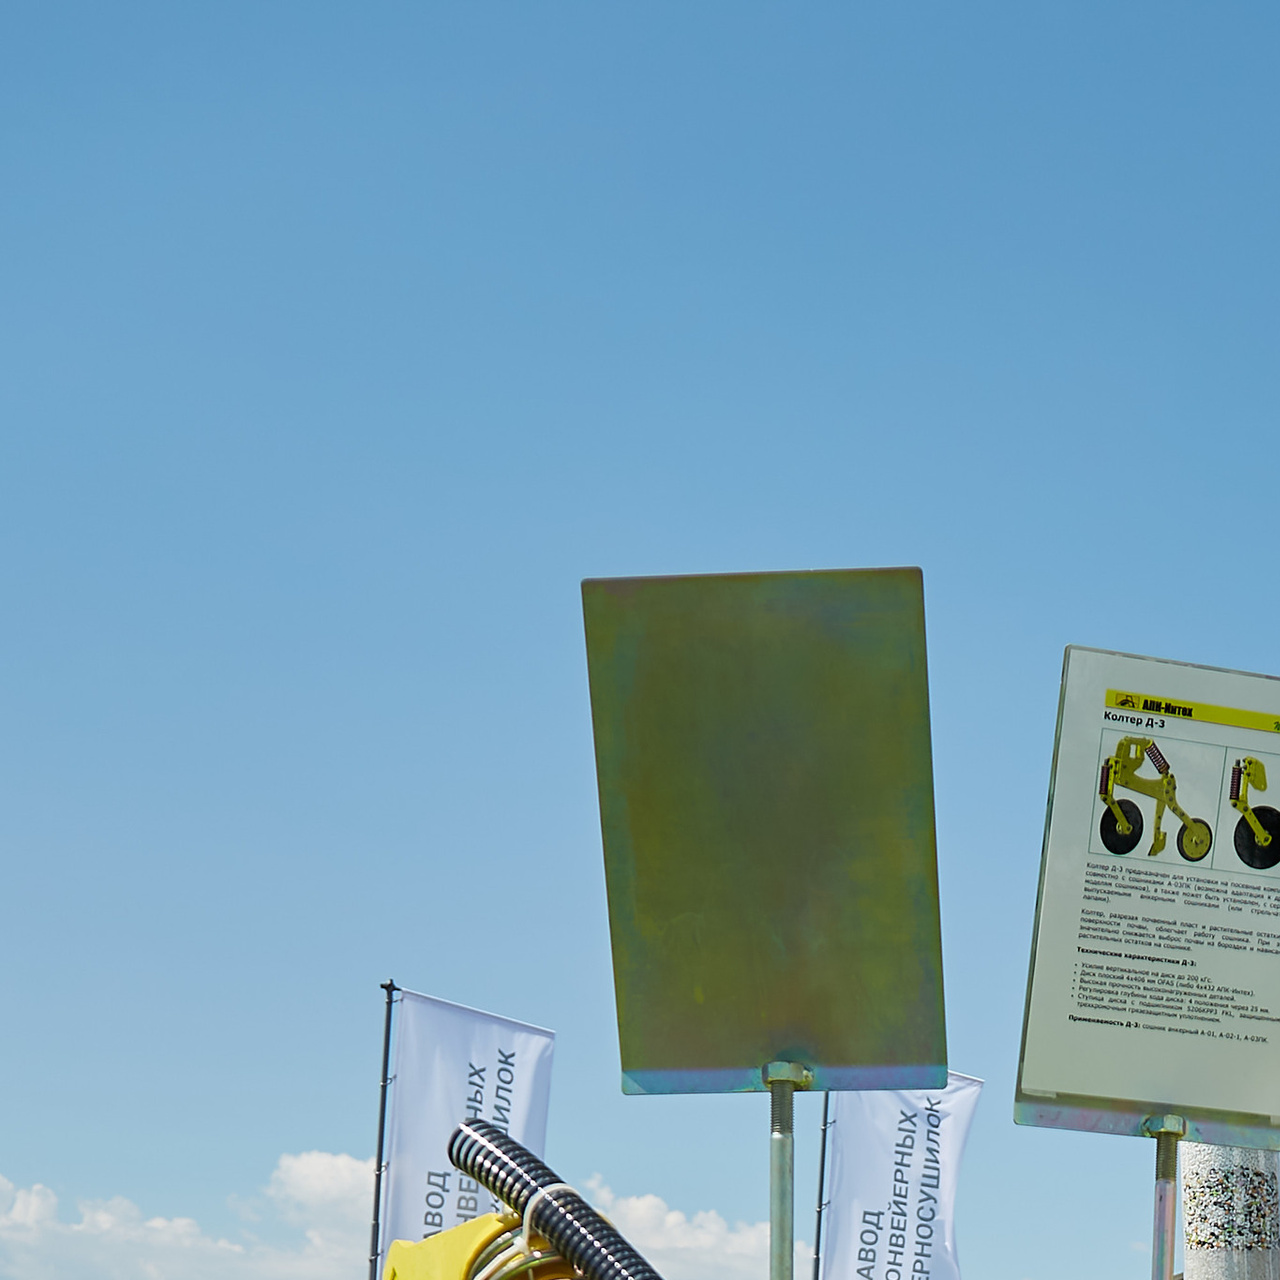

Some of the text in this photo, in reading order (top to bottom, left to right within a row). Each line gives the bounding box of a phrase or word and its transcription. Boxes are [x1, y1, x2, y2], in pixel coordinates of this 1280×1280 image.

[1142, 699, 1193, 717] АПК-Интех
[1104, 711, 1165, 728] Колтер Д-3
